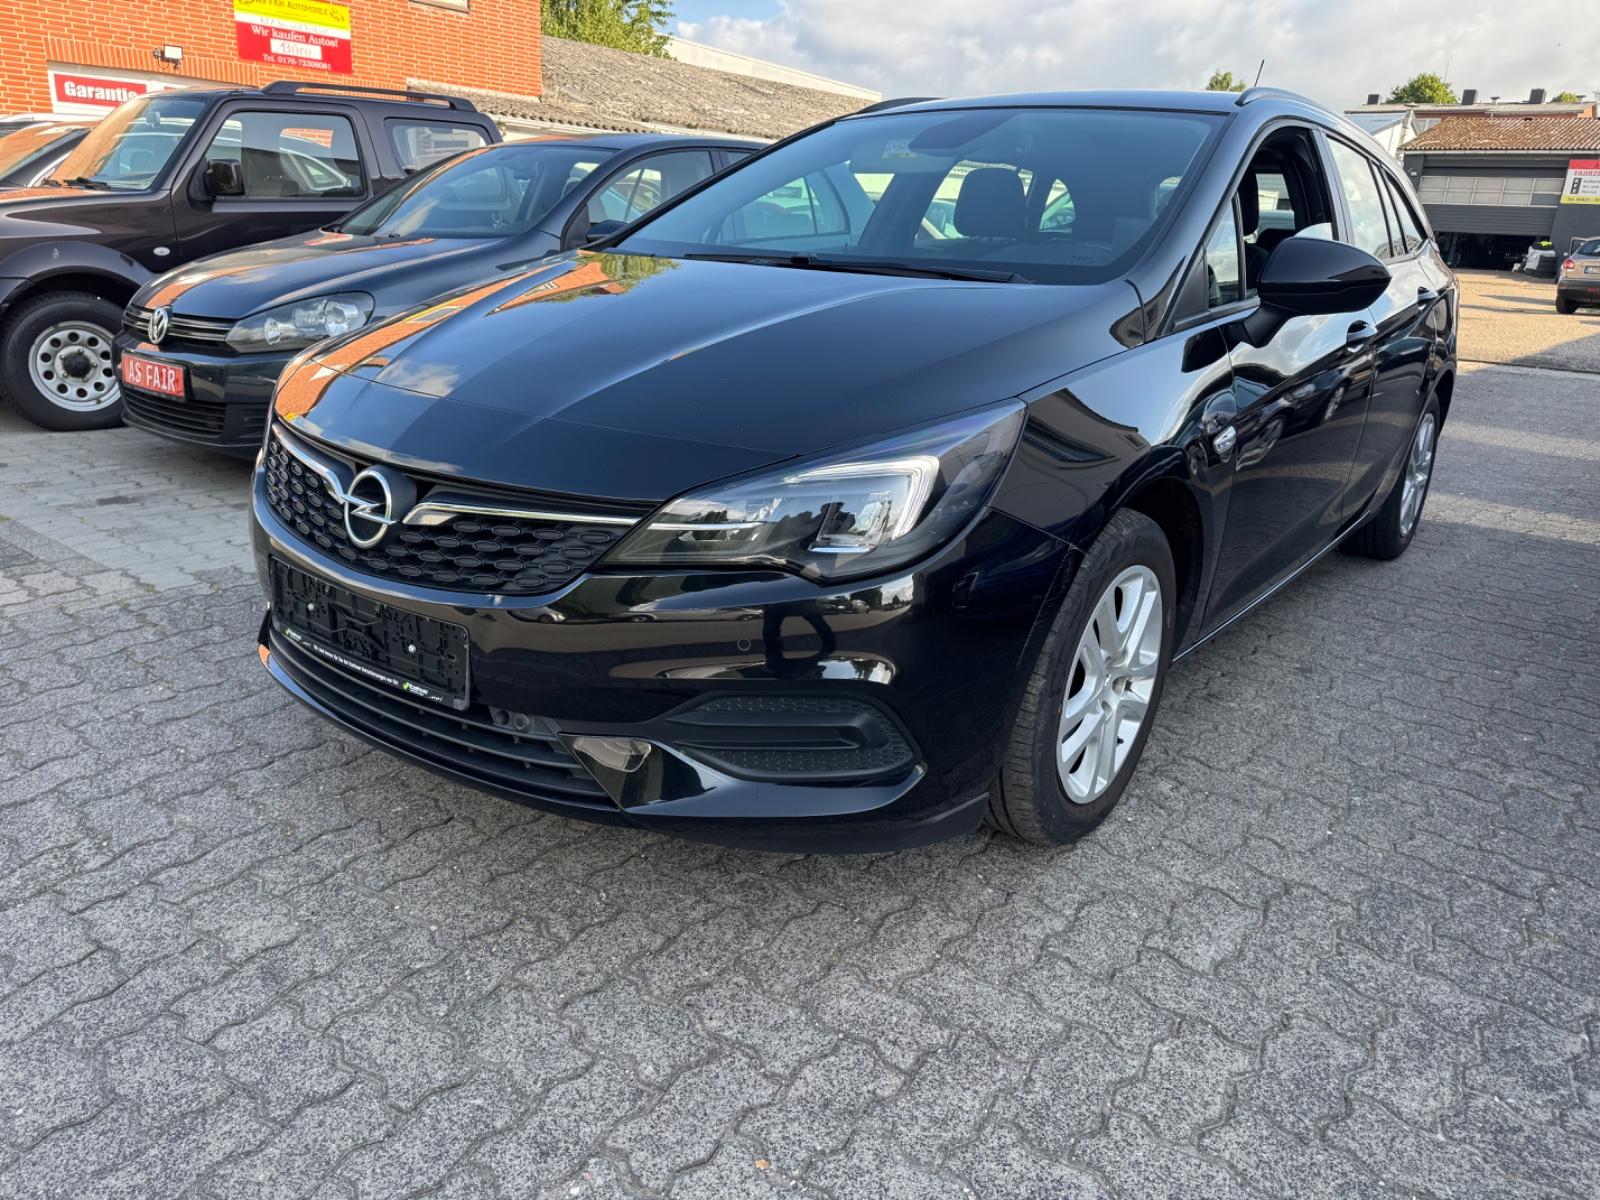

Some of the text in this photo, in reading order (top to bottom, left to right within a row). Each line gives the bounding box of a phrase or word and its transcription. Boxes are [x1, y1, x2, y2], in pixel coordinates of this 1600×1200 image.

[251, 24, 338, 48] Wir kaufen Autos!
[64, 80, 138, 102] Garantie
[128, 360, 176, 392] AS FAIR
